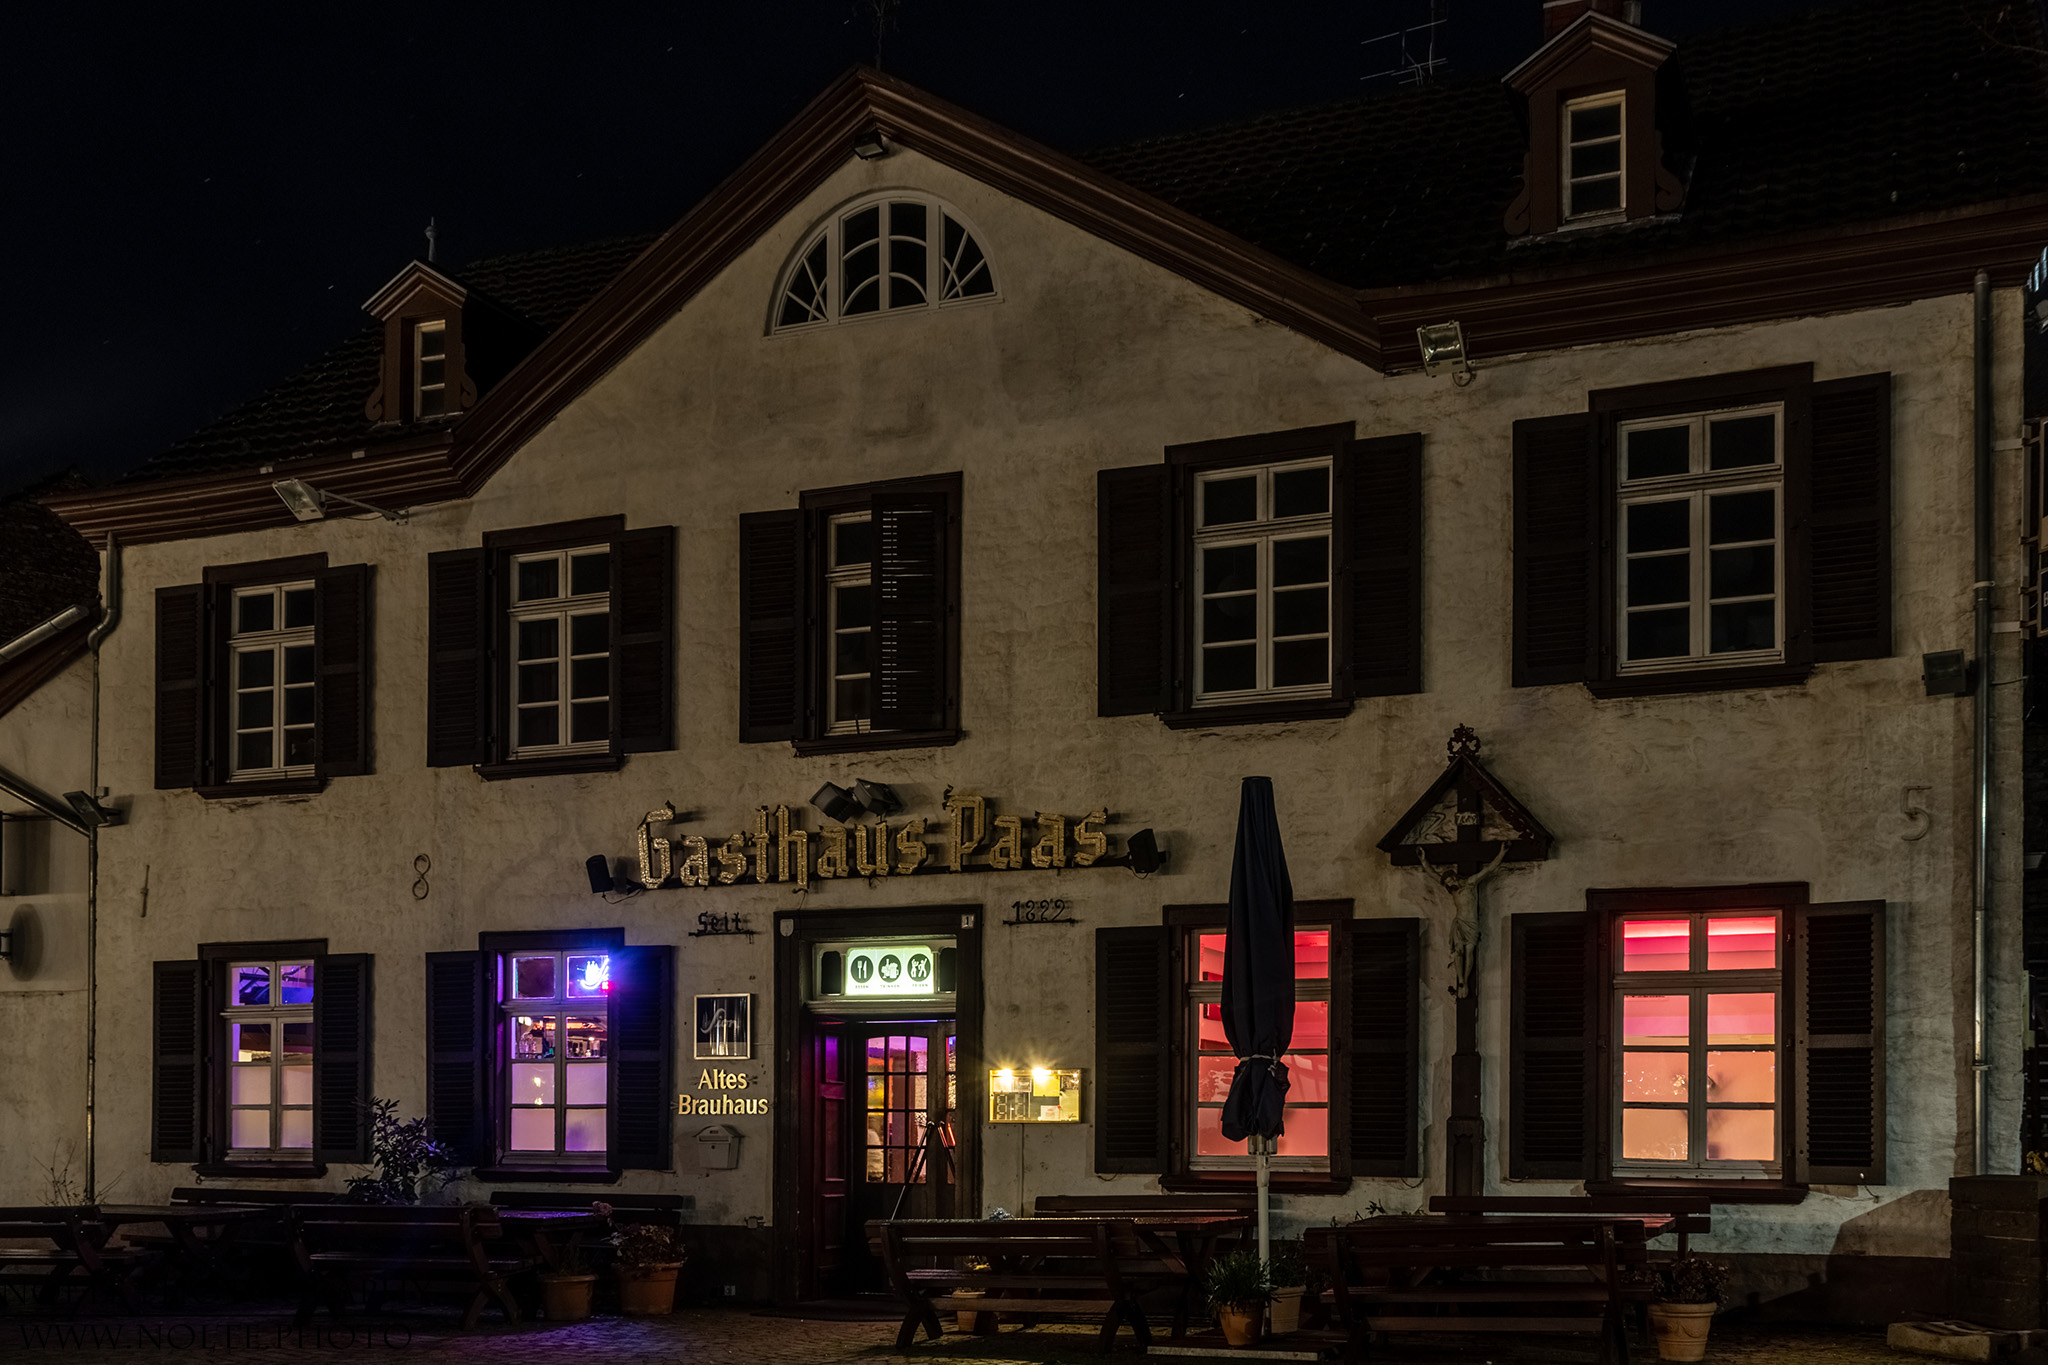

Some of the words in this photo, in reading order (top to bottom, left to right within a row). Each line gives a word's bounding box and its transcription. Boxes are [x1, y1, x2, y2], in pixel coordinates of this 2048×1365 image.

[637, 800, 928, 892] Gasthaus
[942, 785, 1109, 871] Paas
[698, 1068, 748, 1090] Altes
[678, 1094, 769, 1115] Brauhaus
